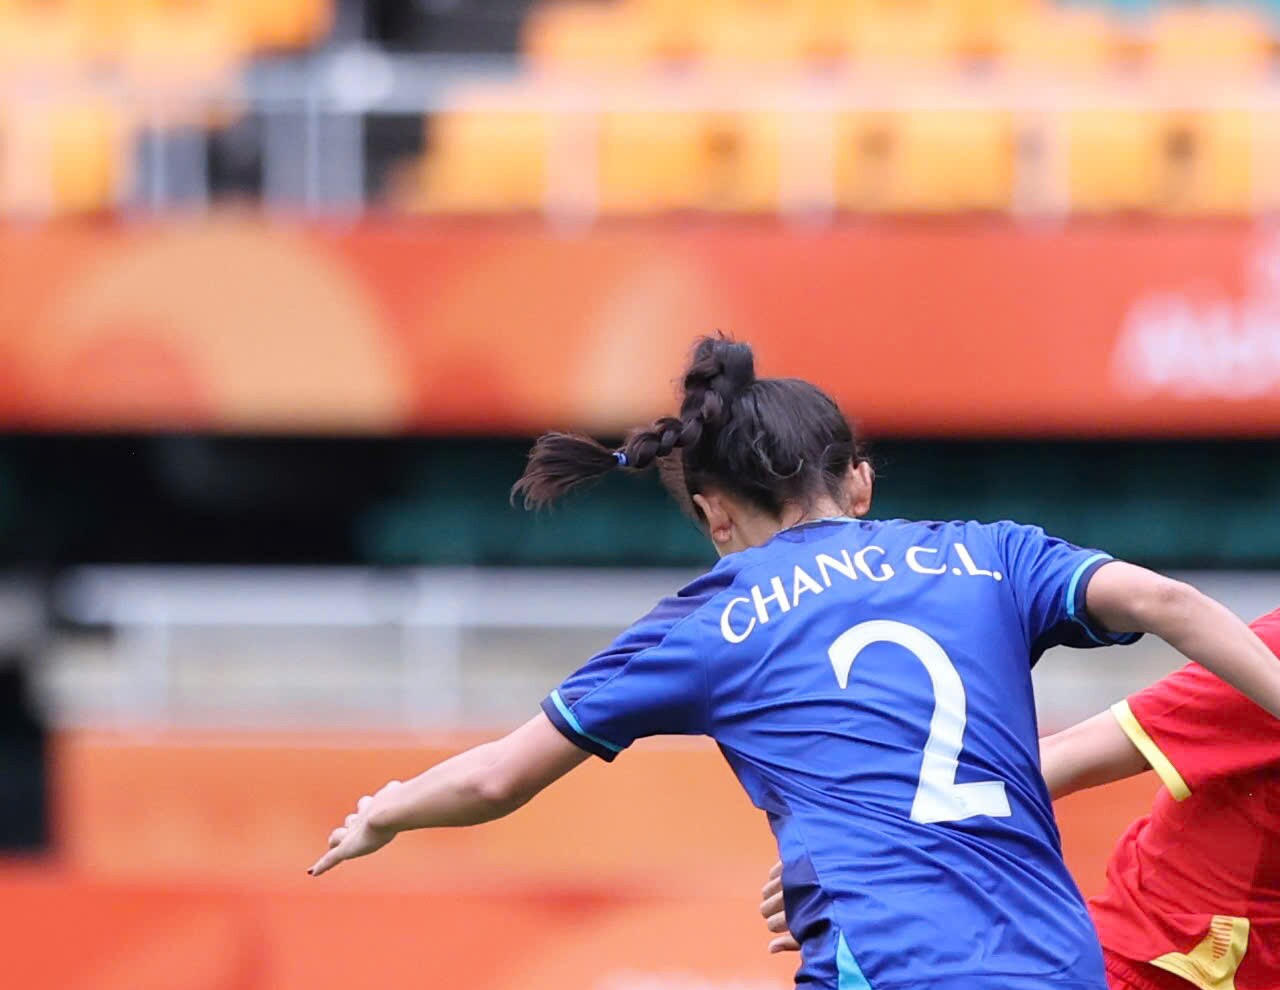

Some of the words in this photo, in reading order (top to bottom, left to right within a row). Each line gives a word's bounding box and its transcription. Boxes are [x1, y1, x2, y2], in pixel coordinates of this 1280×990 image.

[719, 545, 895, 644] CHANG
[905, 542, 1002, 581] C.L.
[827, 619, 1012, 824] 2
